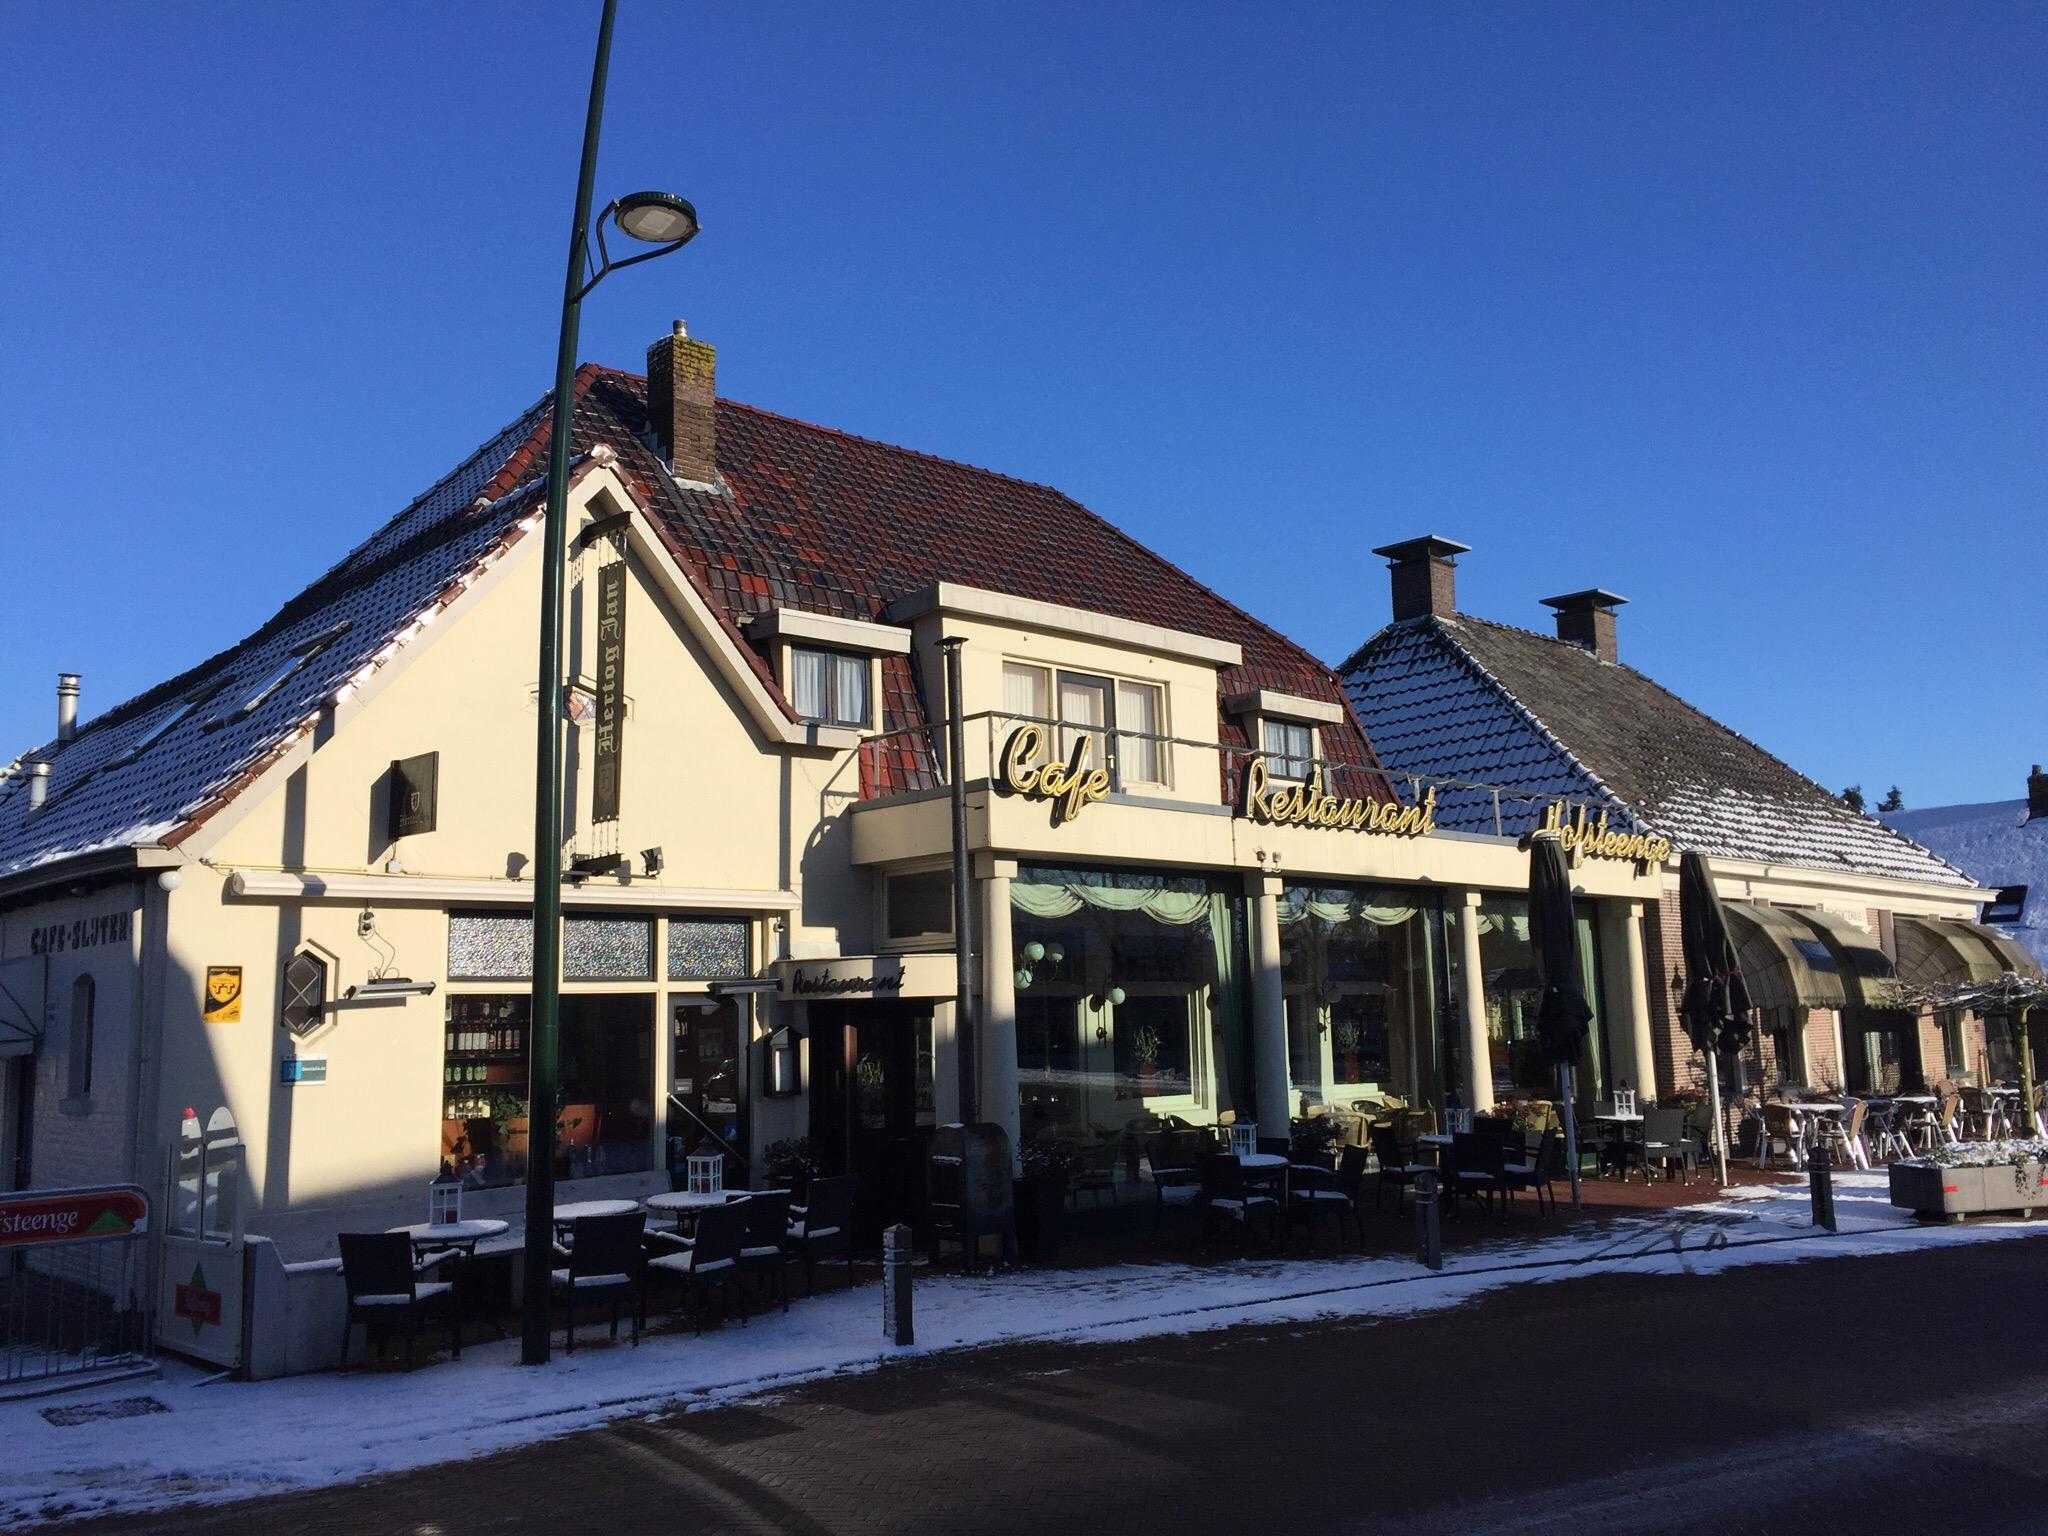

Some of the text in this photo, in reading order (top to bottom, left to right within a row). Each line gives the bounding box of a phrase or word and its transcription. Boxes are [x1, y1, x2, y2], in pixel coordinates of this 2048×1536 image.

[598, 579, 622, 757] Hertog Jan
[1246, 758, 1436, 835] Restaurant
[1531, 800, 1671, 877] Hofsteenge
[792, 965, 906, 994] Restaurant
[0, 1210, 79, 1234] steenge
